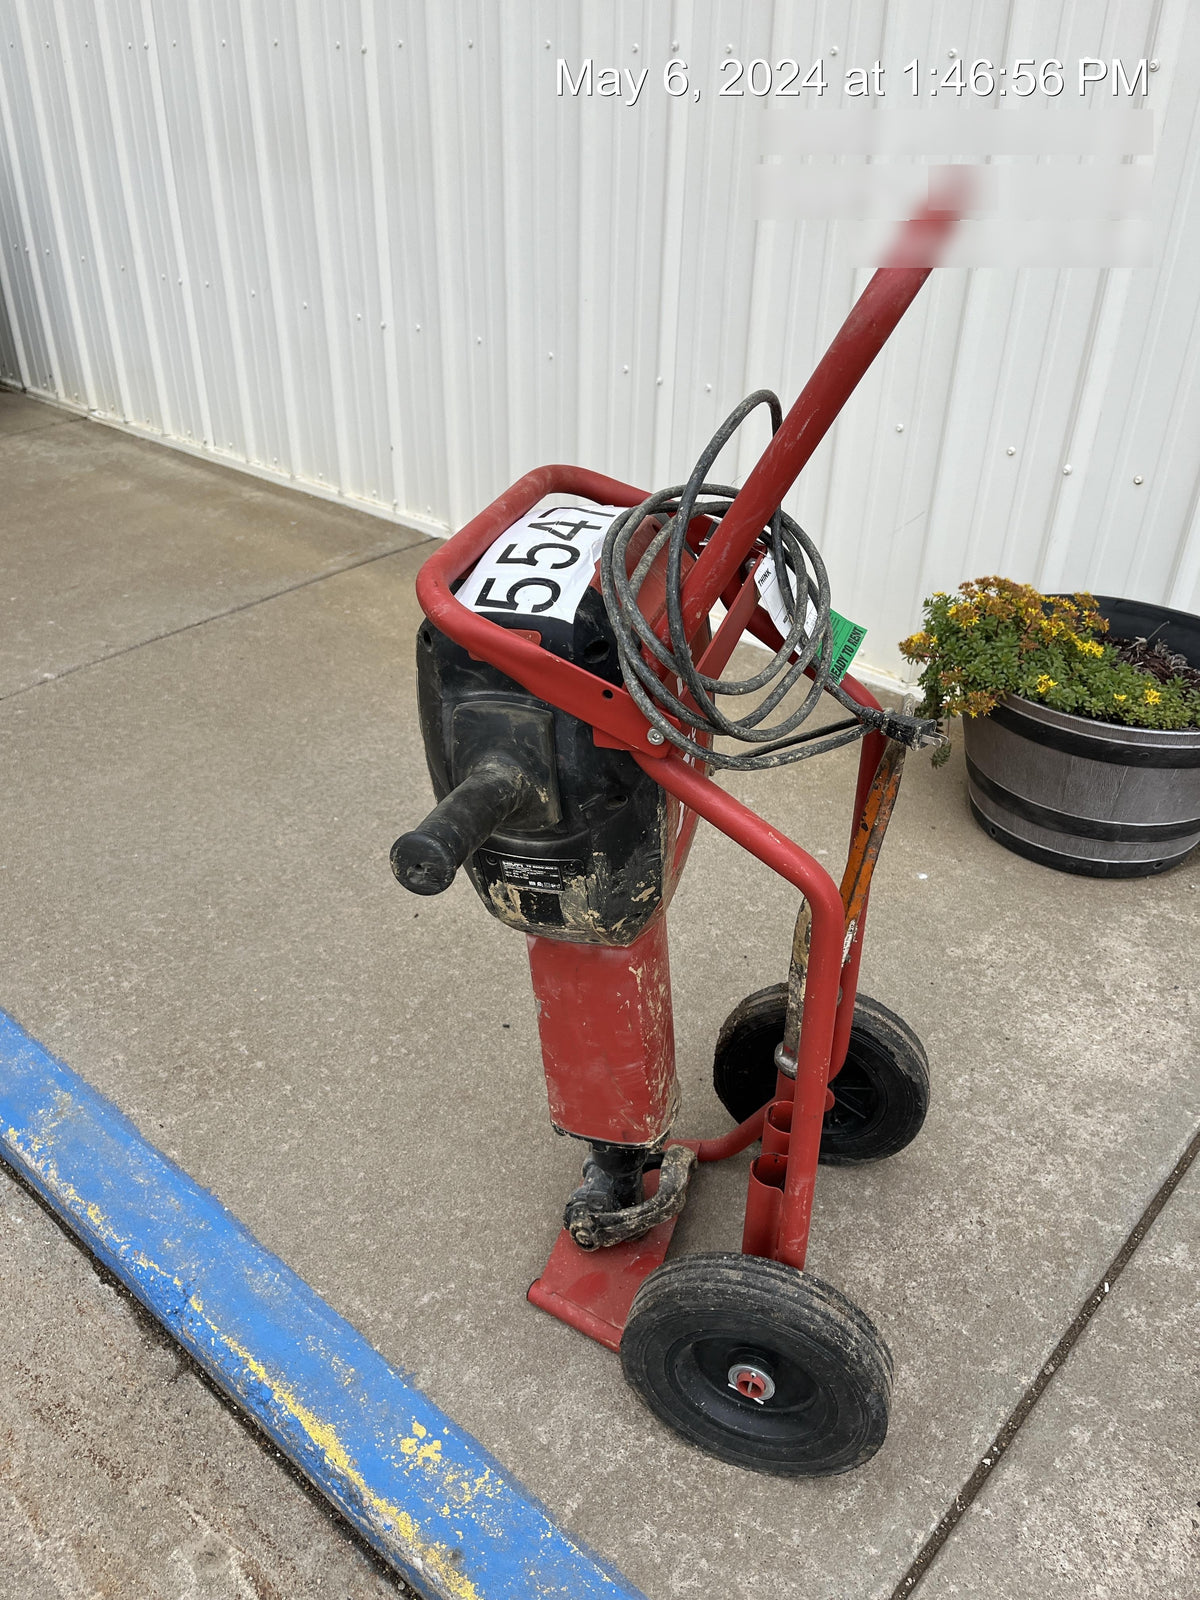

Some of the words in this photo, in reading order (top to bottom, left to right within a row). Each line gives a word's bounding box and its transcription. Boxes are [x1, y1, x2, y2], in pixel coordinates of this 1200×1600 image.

[474, 506, 616, 613] 5547
[757, 568, 772, 588] THINK
[847, 626, 865, 647] RENT
[842, 644, 855, 660] TO
